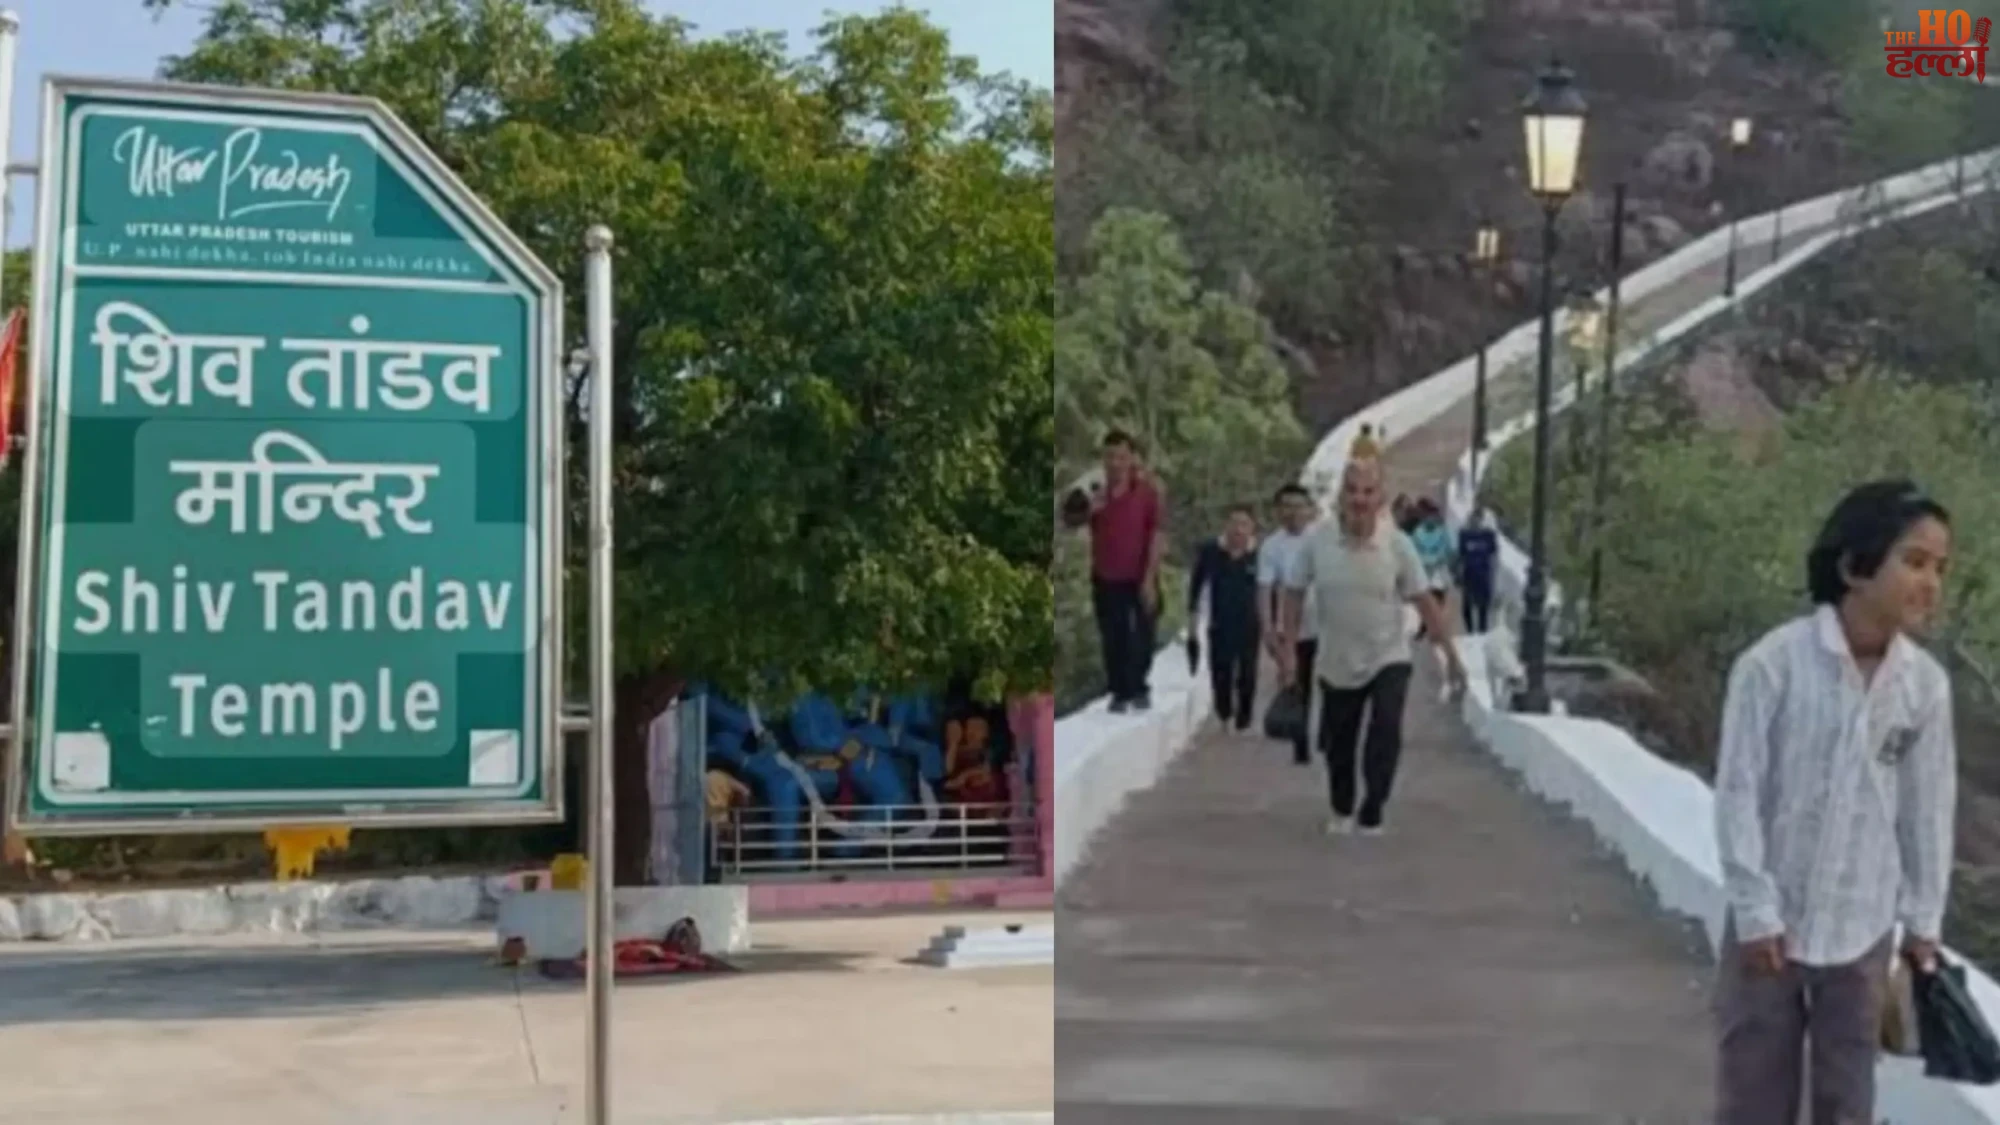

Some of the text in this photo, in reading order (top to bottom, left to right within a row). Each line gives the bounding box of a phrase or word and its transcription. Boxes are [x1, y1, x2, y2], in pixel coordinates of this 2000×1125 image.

[113, 125, 350, 222] Uttar Pradesh
[125, 222, 353, 246] UTTAR PRADESH TOURISM
[135, 244, 181, 261] nahi
[303, 249, 357, 269] India
[363, 253, 406, 269] nahi
[91, 301, 501, 412] शिव तांडव
[170, 430, 439, 538] मन्दिर
[74, 565, 512, 634] Shiv Tandav
[170, 667, 440, 750] Temple
